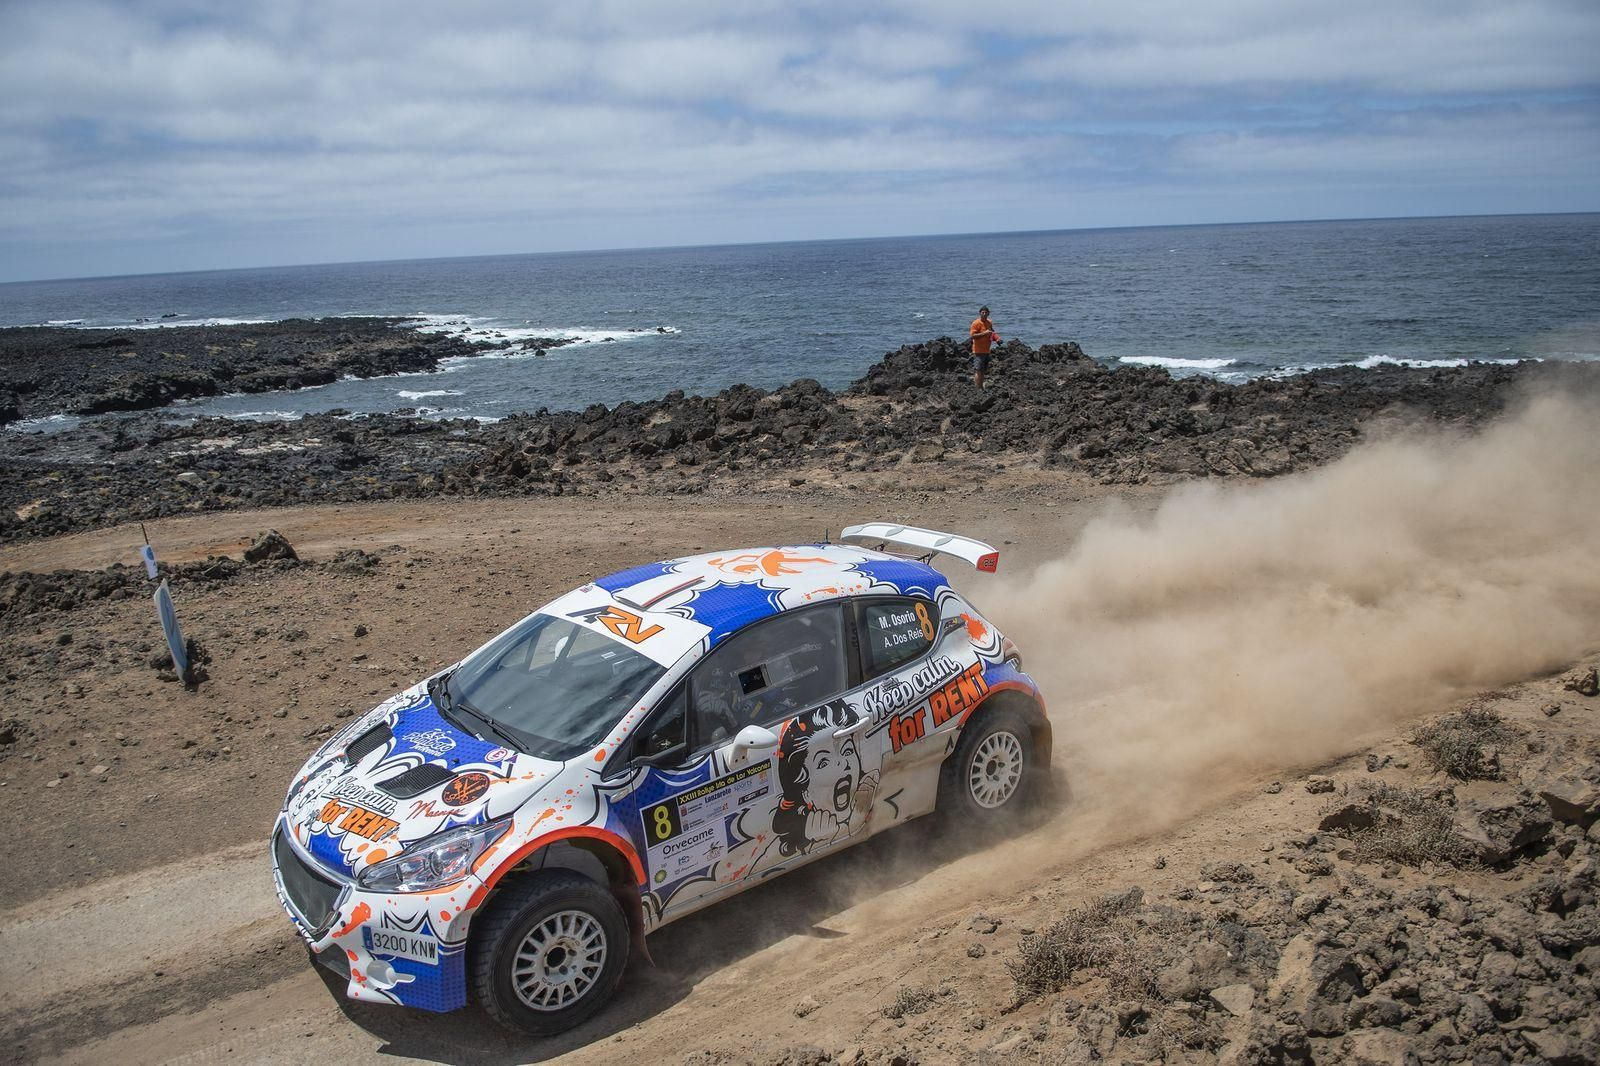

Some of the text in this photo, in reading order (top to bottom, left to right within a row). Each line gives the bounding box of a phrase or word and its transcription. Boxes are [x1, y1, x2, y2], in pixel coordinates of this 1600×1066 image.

[878, 610, 916, 629] M. Osorio
[914, 602, 934, 641] 8
[884, 628, 923, 648] A. Dos Reis
[863, 654, 964, 726] Keep calm
[888, 662, 990, 754] for RENT
[330, 776, 366, 802] Keep
[360, 790, 398, 818] calm
[680, 791, 698, 804] XXIII
[698, 785, 715, 797] Rallye
[317, 798, 348, 825] for
[338, 806, 400, 842] RENT
[654, 805, 672, 840] 8
[662, 827, 714, 855] Orvecame
[373, 932, 436, 958] 3200 KNW
